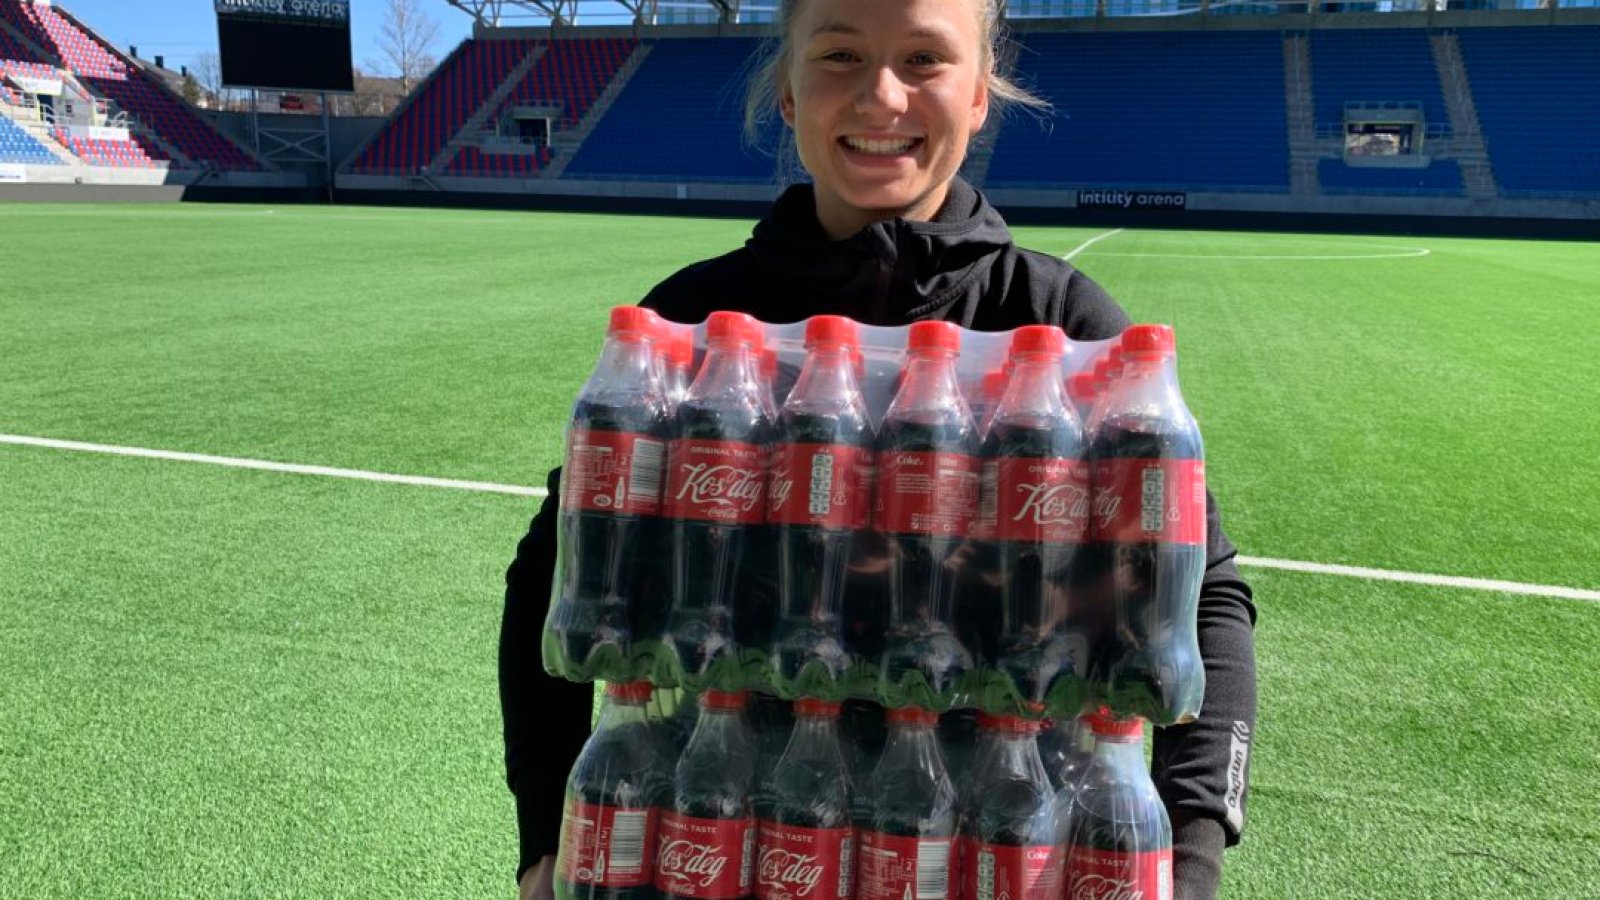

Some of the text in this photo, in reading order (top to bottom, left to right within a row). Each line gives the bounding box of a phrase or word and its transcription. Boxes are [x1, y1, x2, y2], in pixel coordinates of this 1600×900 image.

[291, 0, 343, 13] arena
[1080, 190, 1184, 208] intility arena
[688, 446, 730, 456] ORIGINAL
[691, 825, 718, 834] TASTE
[787, 833, 813, 842] TASTE
[1026, 850, 1050, 860] Coke
[685, 845, 727, 888] deg
[781, 853, 824, 896] deg
